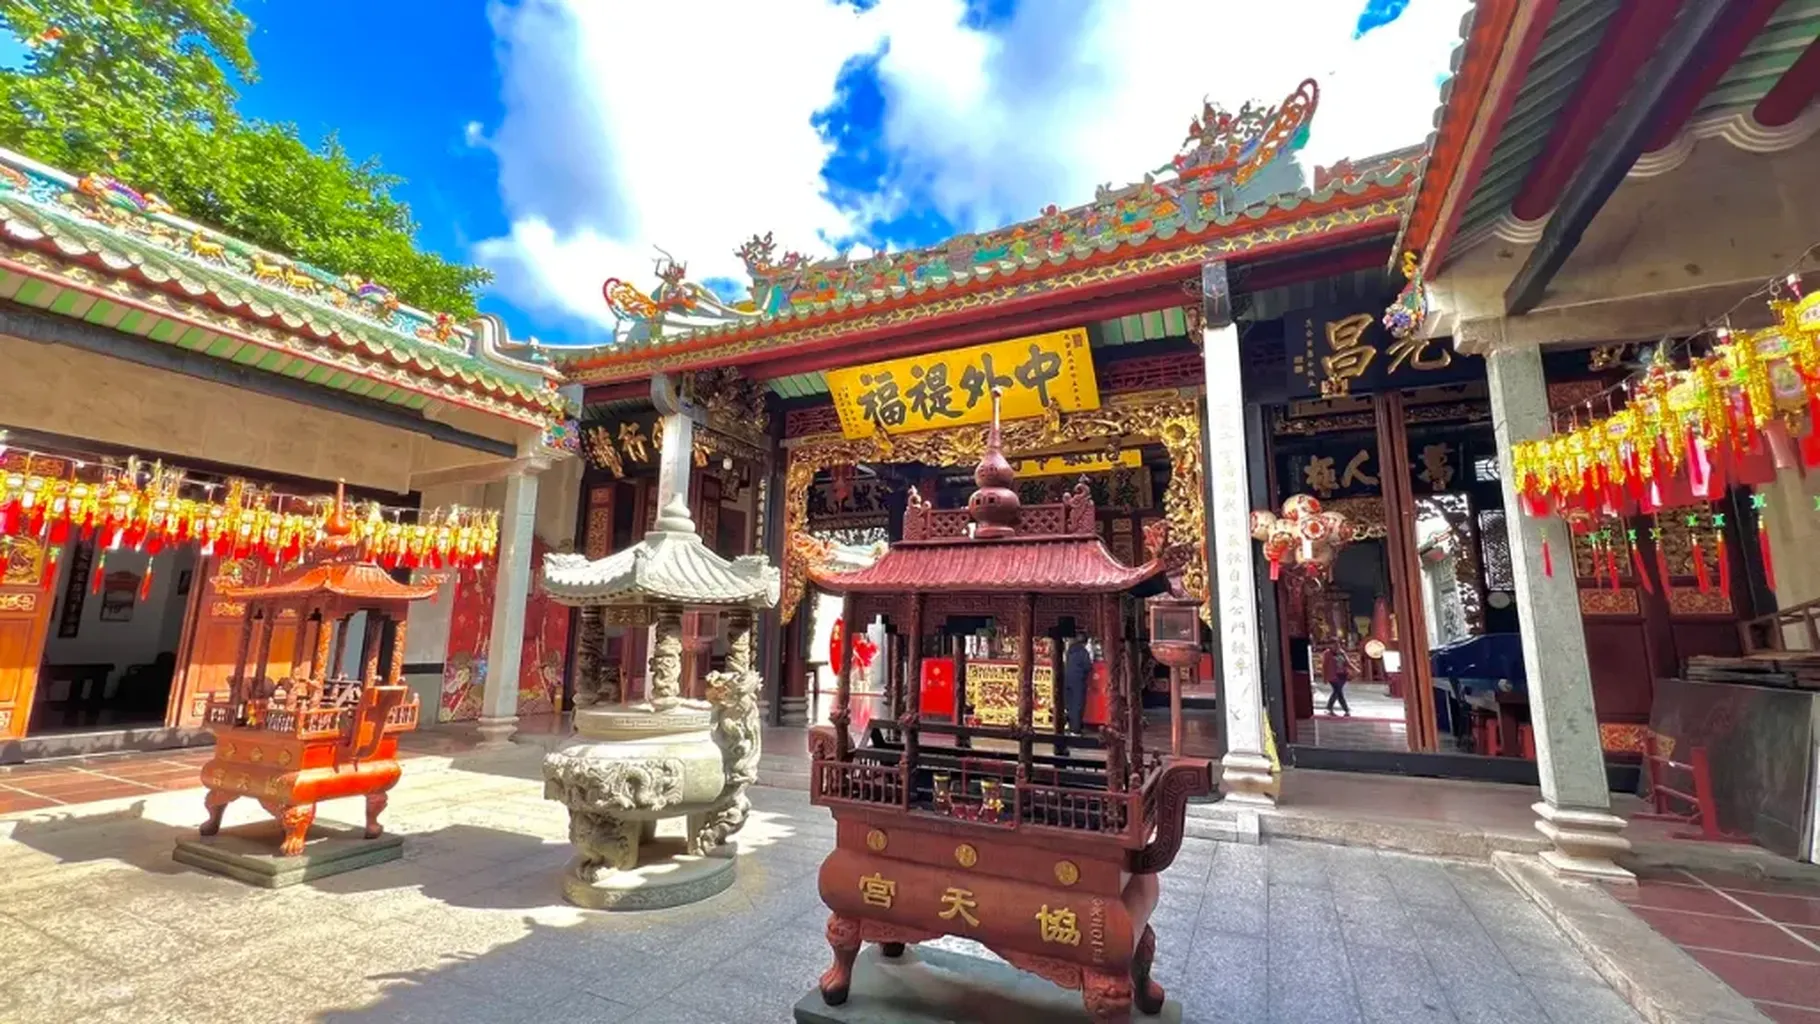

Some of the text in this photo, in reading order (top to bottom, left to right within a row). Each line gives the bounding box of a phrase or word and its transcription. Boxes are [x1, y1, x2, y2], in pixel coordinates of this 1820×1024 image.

[1303, 442, 1455, 492] 萬人極
[857, 871, 1082, 948] 協天宮
